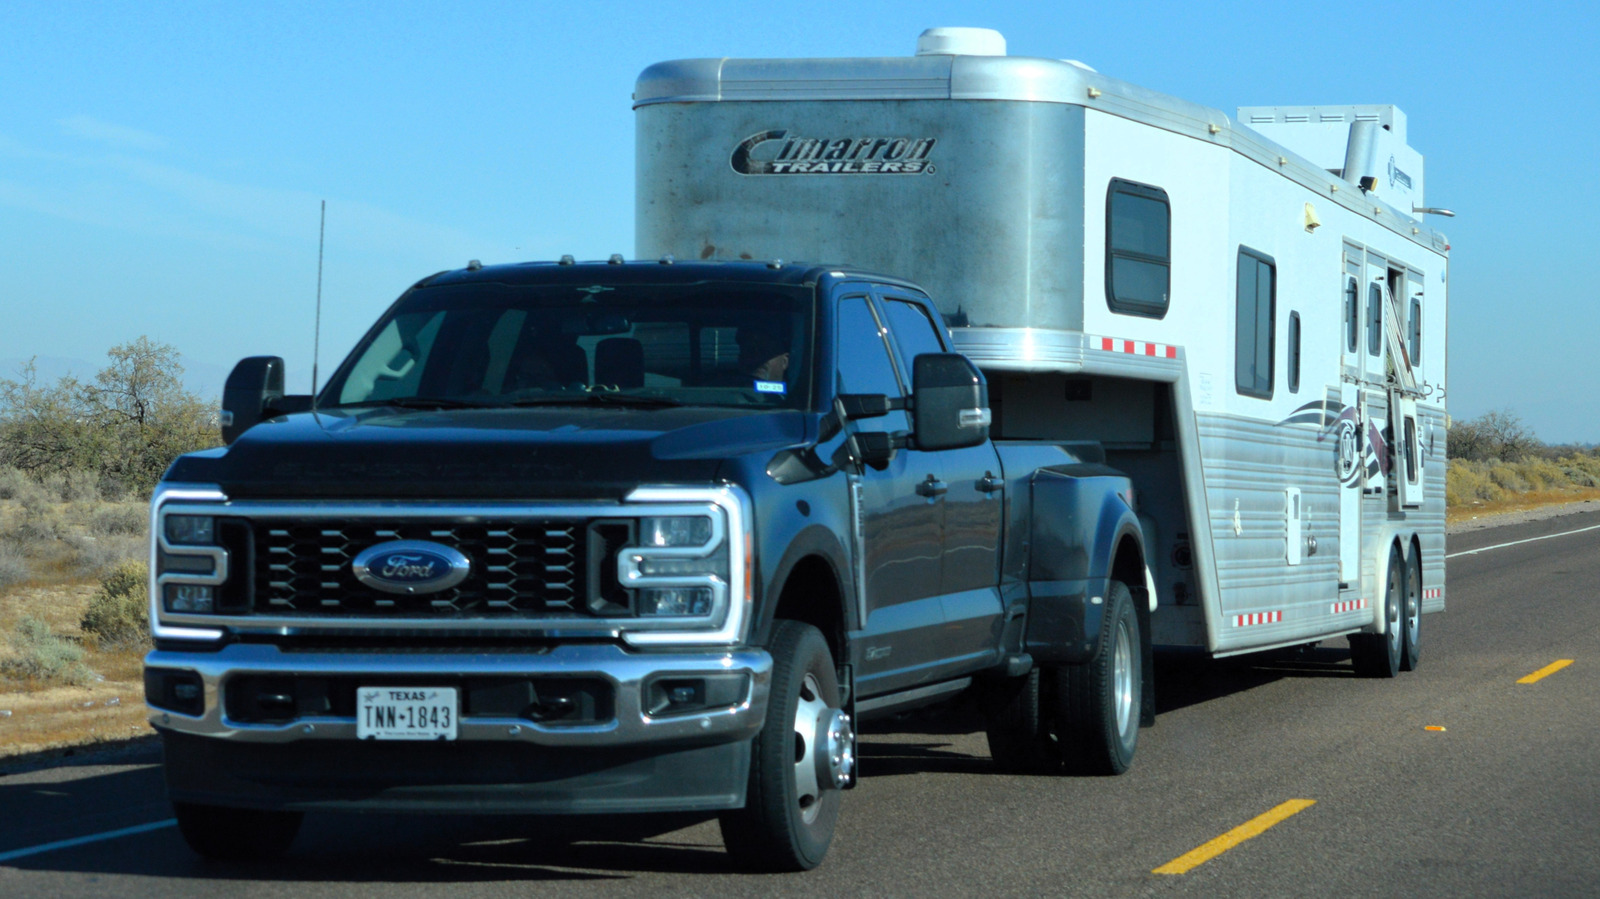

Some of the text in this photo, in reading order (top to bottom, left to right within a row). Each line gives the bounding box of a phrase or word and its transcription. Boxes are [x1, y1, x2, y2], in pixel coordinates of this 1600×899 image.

[730, 129, 936, 174] Cimarron
[771, 162, 923, 173] TRAILERS
[381, 554, 435, 577] Ford
[389, 691, 425, 701] TEXAS
